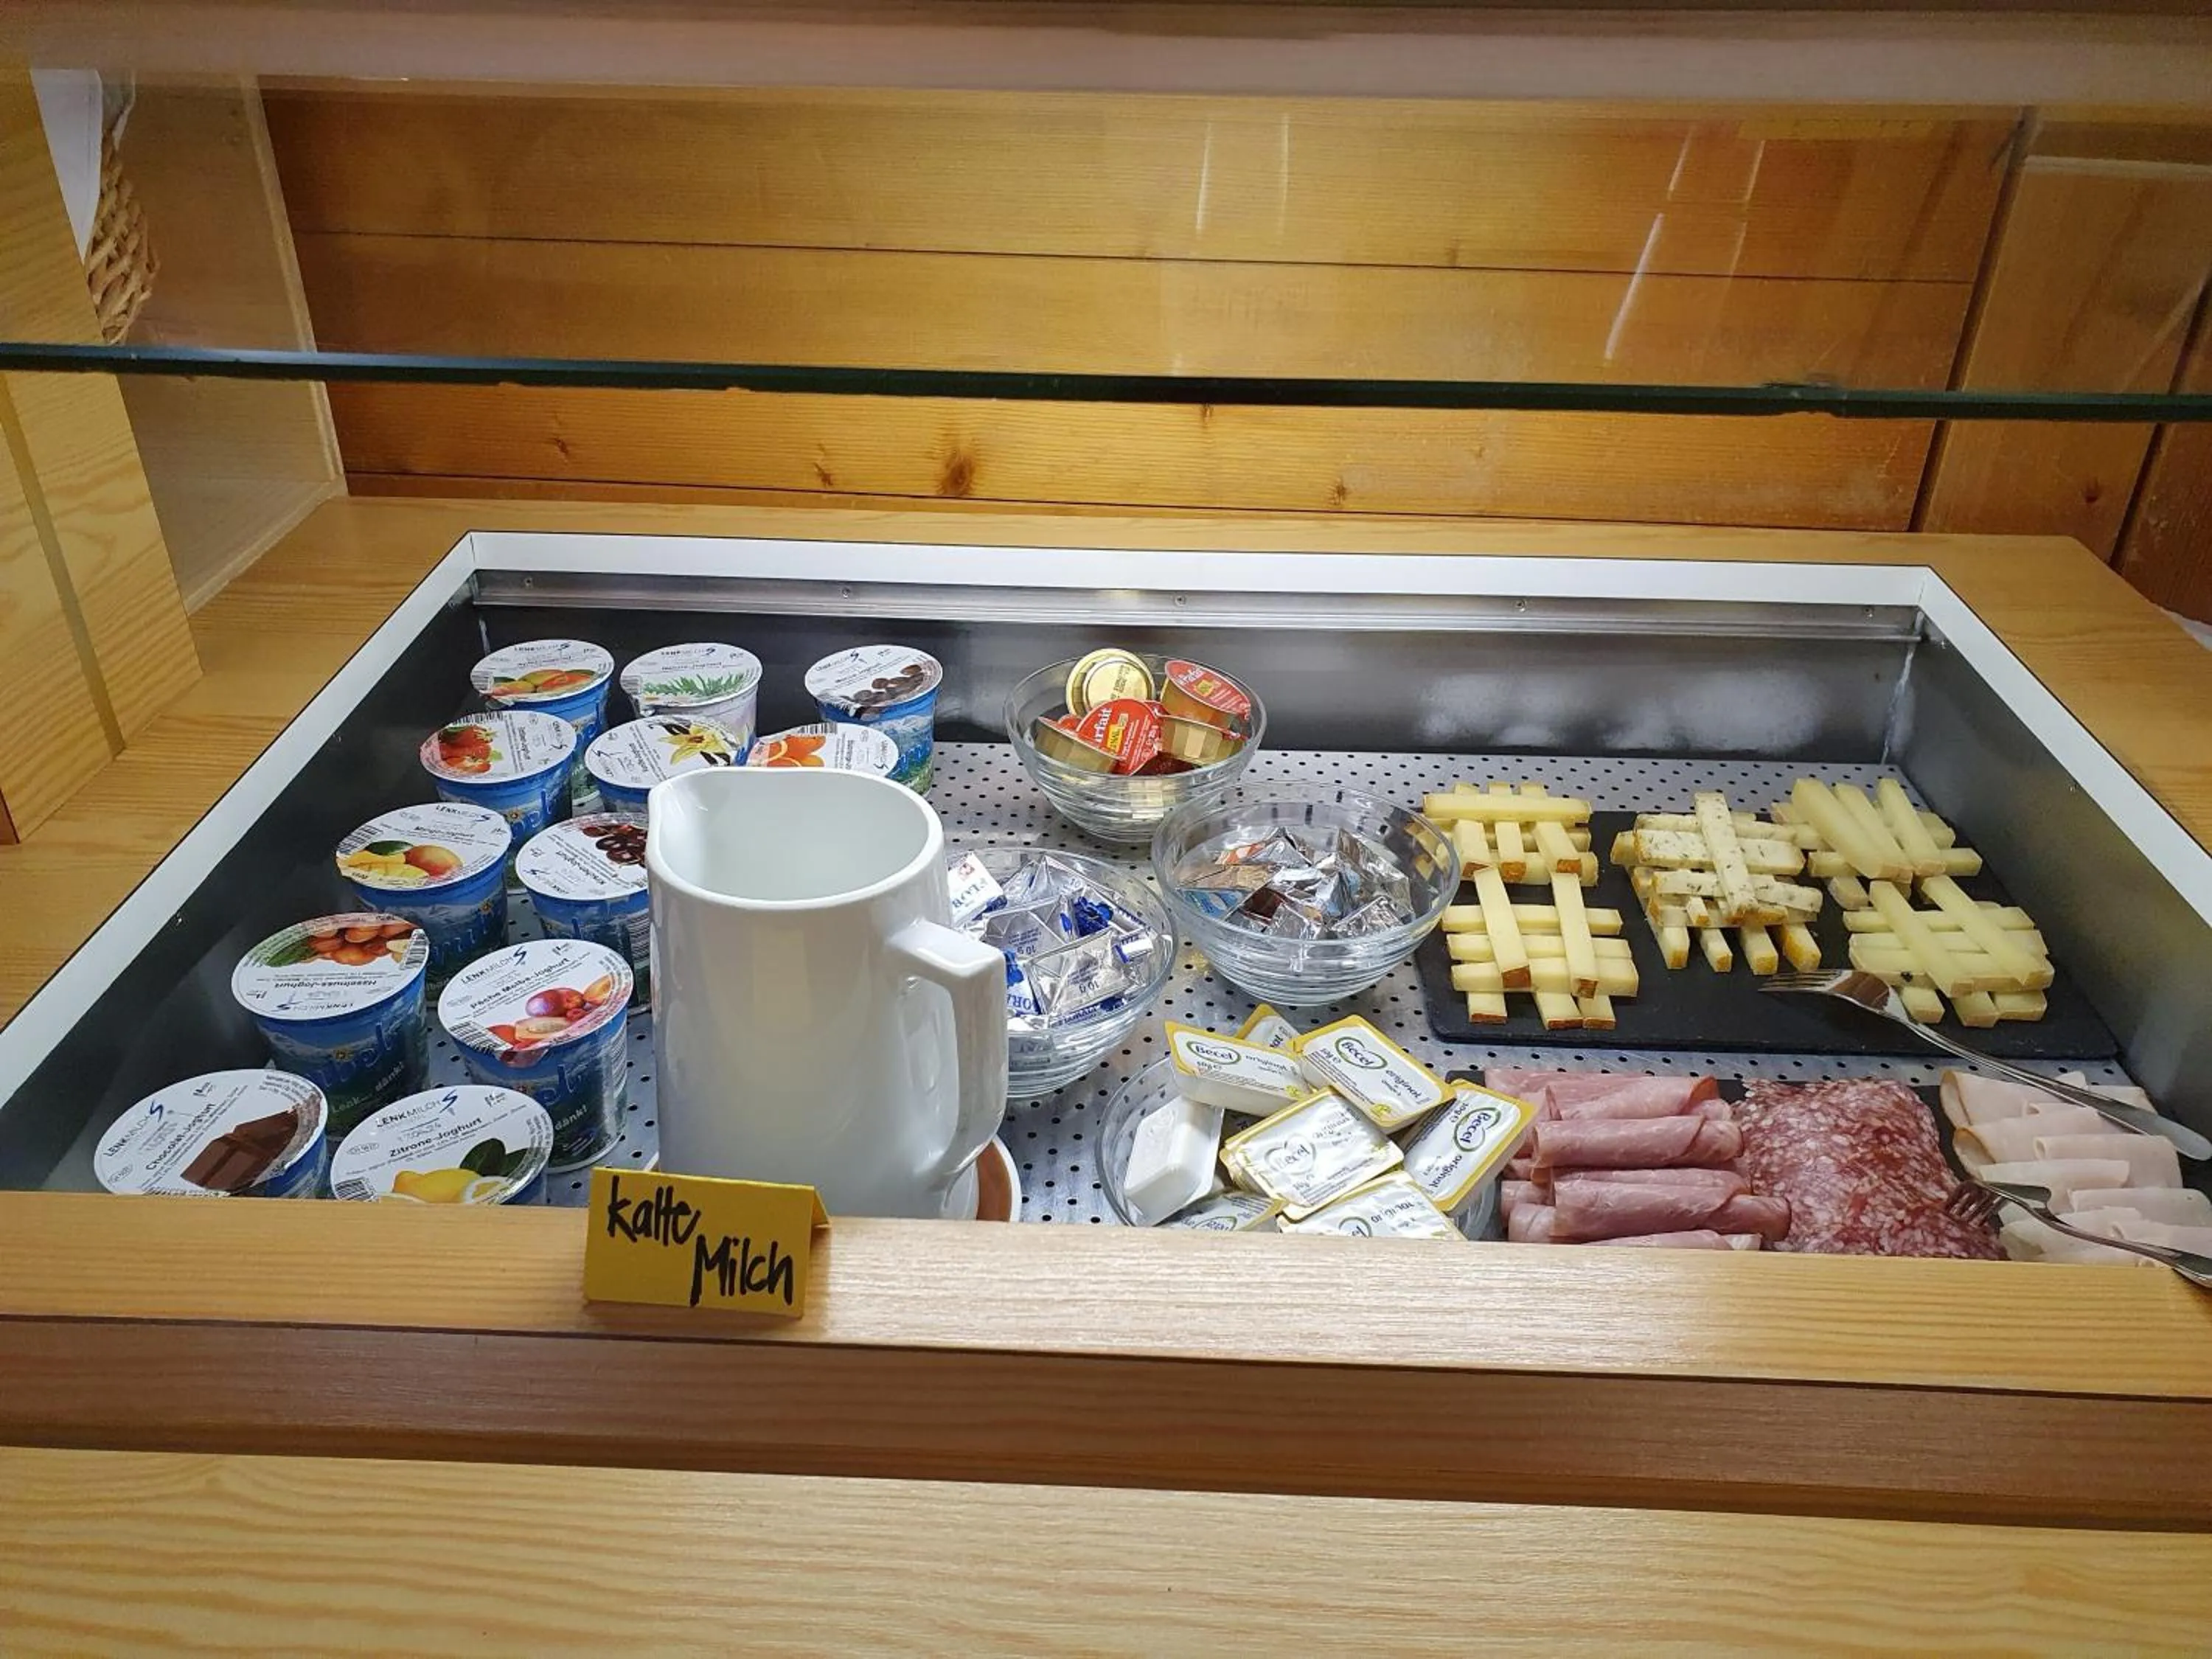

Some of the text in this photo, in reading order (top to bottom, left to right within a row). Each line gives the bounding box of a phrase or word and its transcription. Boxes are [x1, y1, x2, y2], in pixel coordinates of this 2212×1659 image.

[1195, 1045, 1234, 1061] Becel
[1341, 1041, 1375, 1066] Becel
[1385, 1069, 1424, 1099] original
[389, 1118, 483, 1157] Zitrone-Joghurt
[1460, 1111, 1492, 1144] Becel
[1429, 1154, 1463, 1189] original
[607, 1175, 701, 1247] kalte
[689, 1233, 794, 1308] Milch
